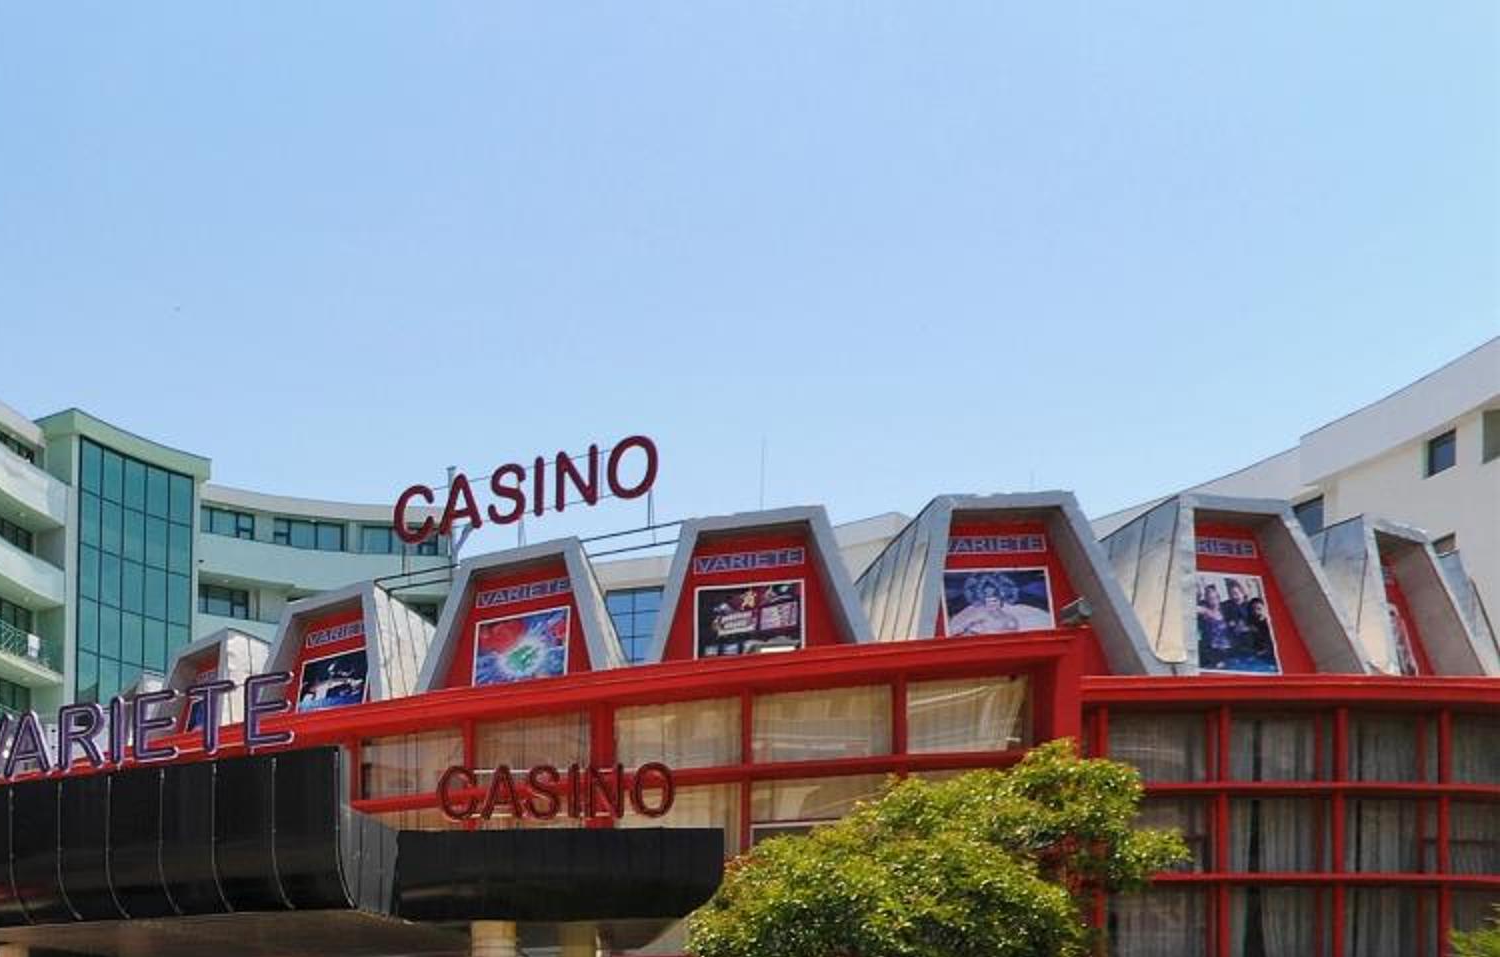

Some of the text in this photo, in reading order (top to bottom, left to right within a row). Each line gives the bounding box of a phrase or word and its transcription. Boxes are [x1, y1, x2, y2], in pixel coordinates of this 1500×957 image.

[393, 435, 659, 544] CASINO
[699, 548, 801, 572] VARIETE
[479, 579, 569, 606] VARIETE
[436, 761, 675, 821] CASINO
